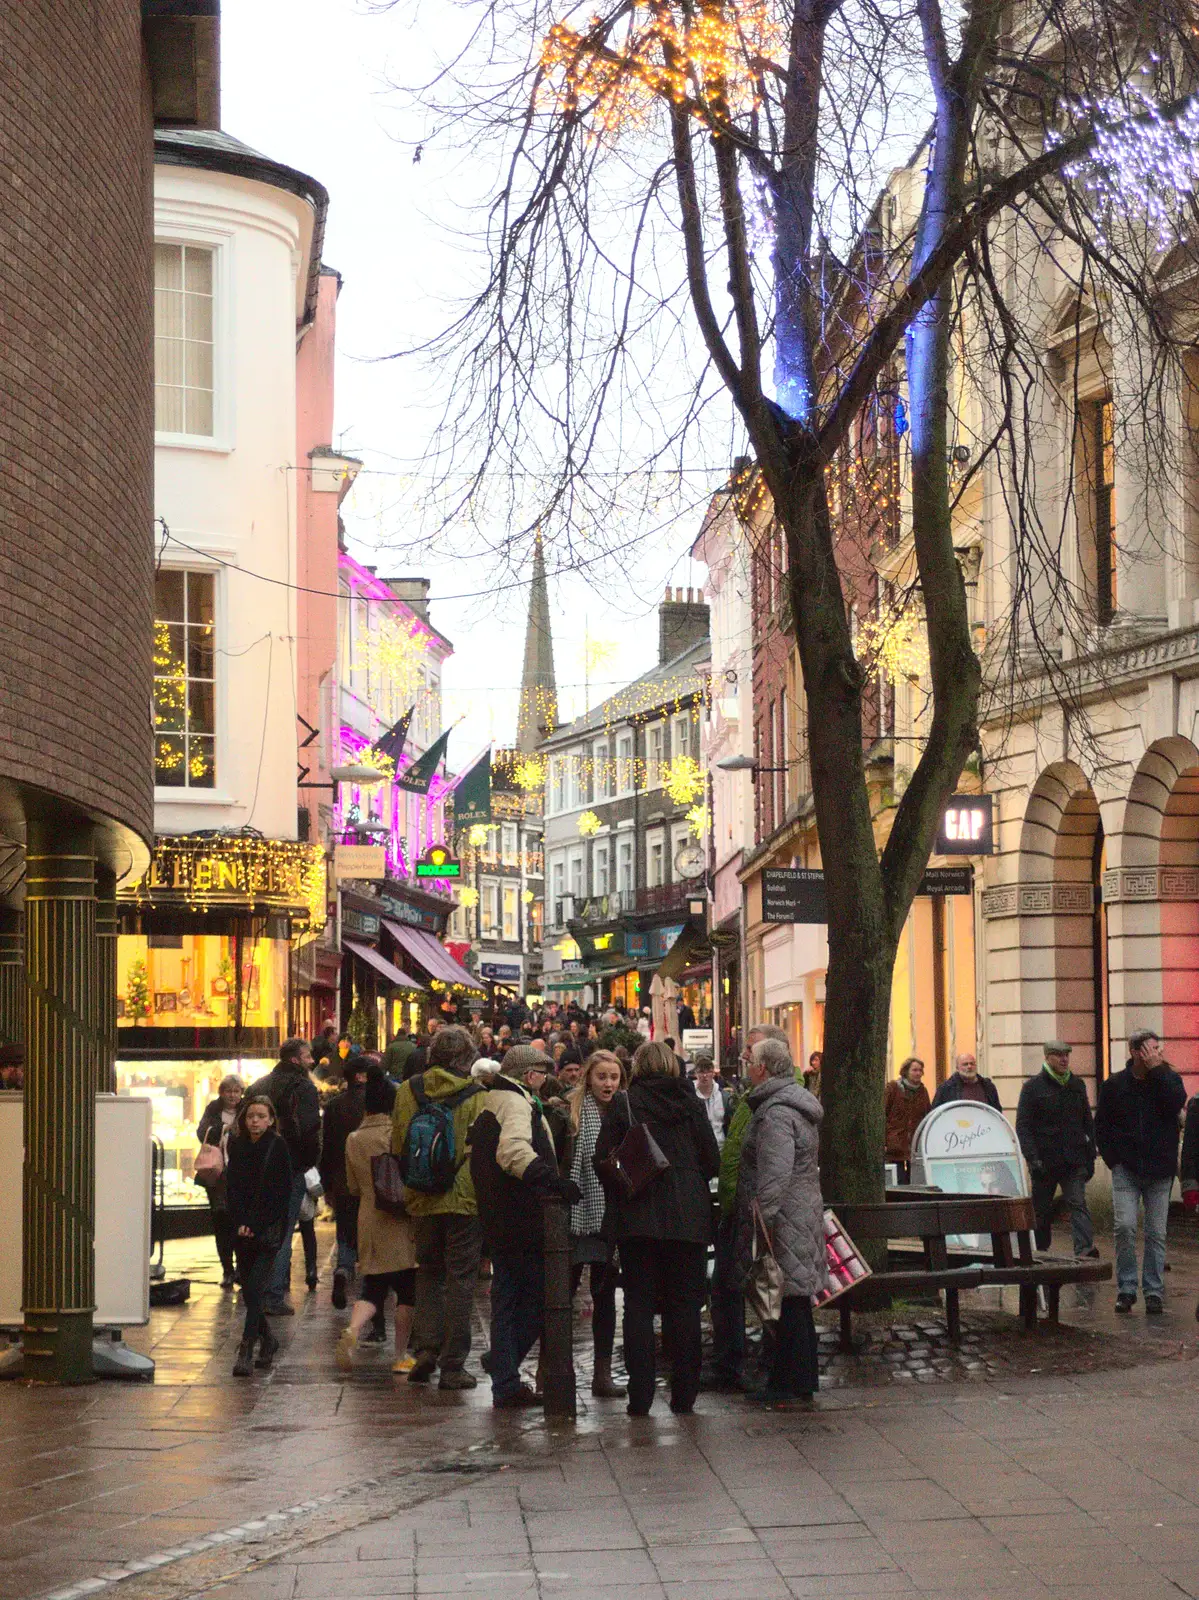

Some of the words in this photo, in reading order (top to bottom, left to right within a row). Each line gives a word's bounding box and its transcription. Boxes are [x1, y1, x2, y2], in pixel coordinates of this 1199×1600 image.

[458, 811, 487, 820] ROLEX
[945, 809, 983, 840] GAP
[417, 864, 460, 876] ROLEX
[766, 870, 796, 879] CHAPELFIELD
[926, 884, 943, 893] Royal
[944, 1124, 991, 1152] Dipples
